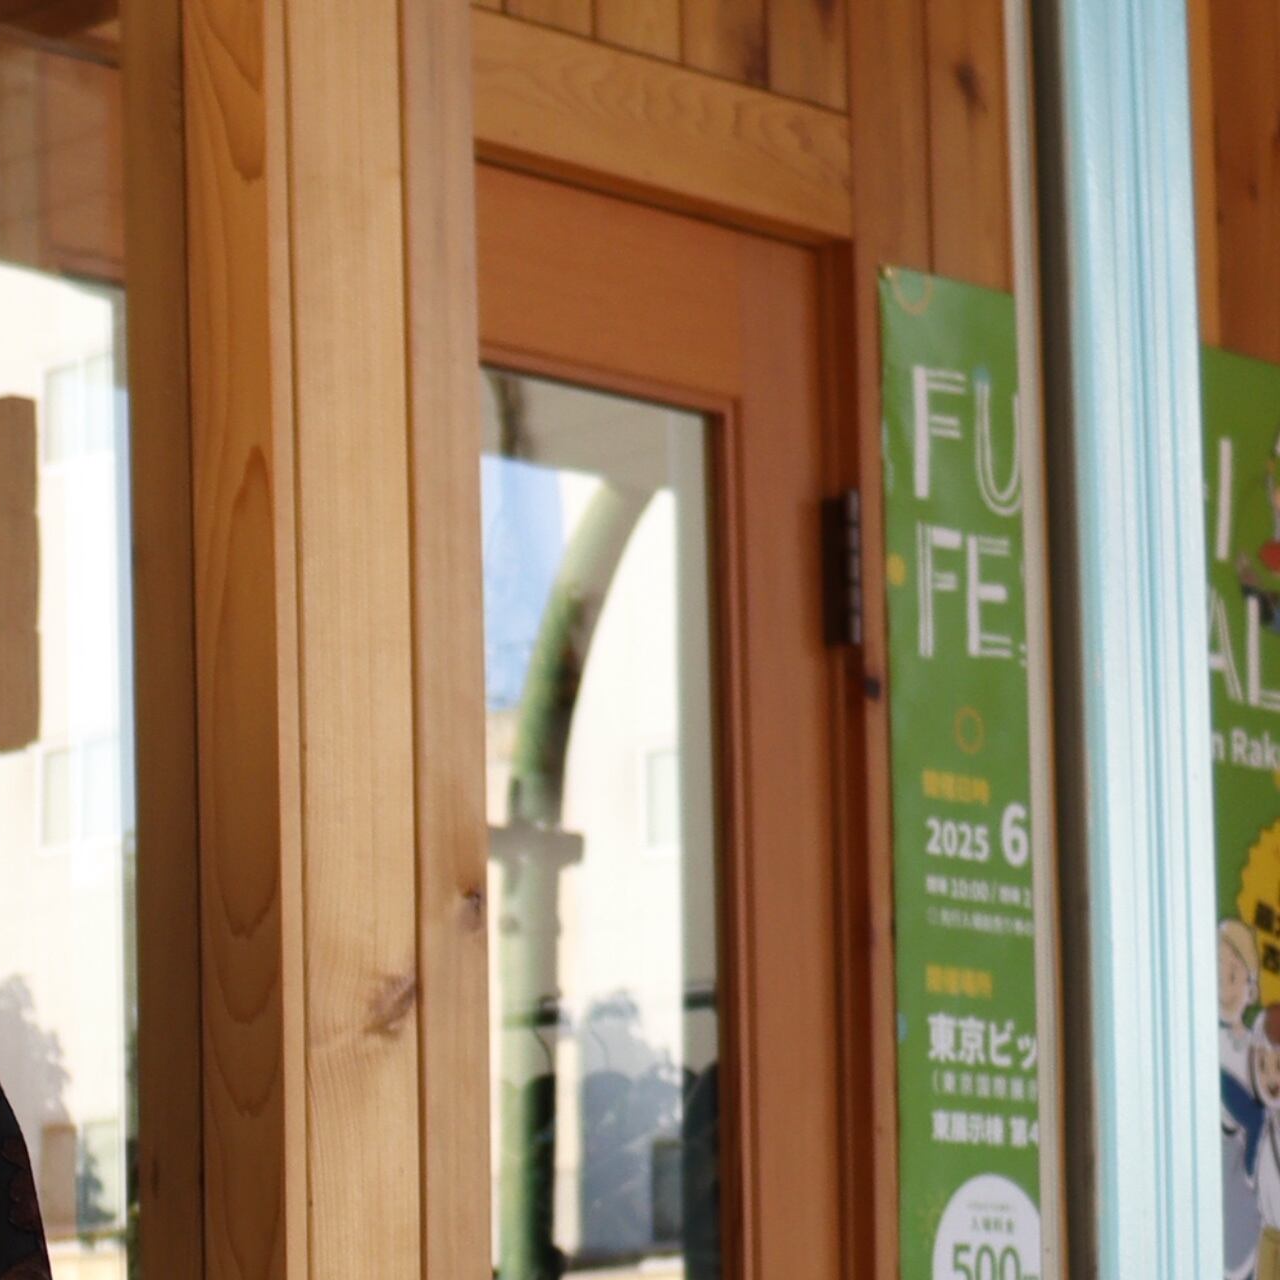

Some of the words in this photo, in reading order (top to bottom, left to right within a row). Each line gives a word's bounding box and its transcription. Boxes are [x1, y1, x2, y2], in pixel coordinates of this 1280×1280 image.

[916, 521, 1027, 669] FE
[925, 815, 991, 863] 2025
[1001, 801, 1030, 869] 6
